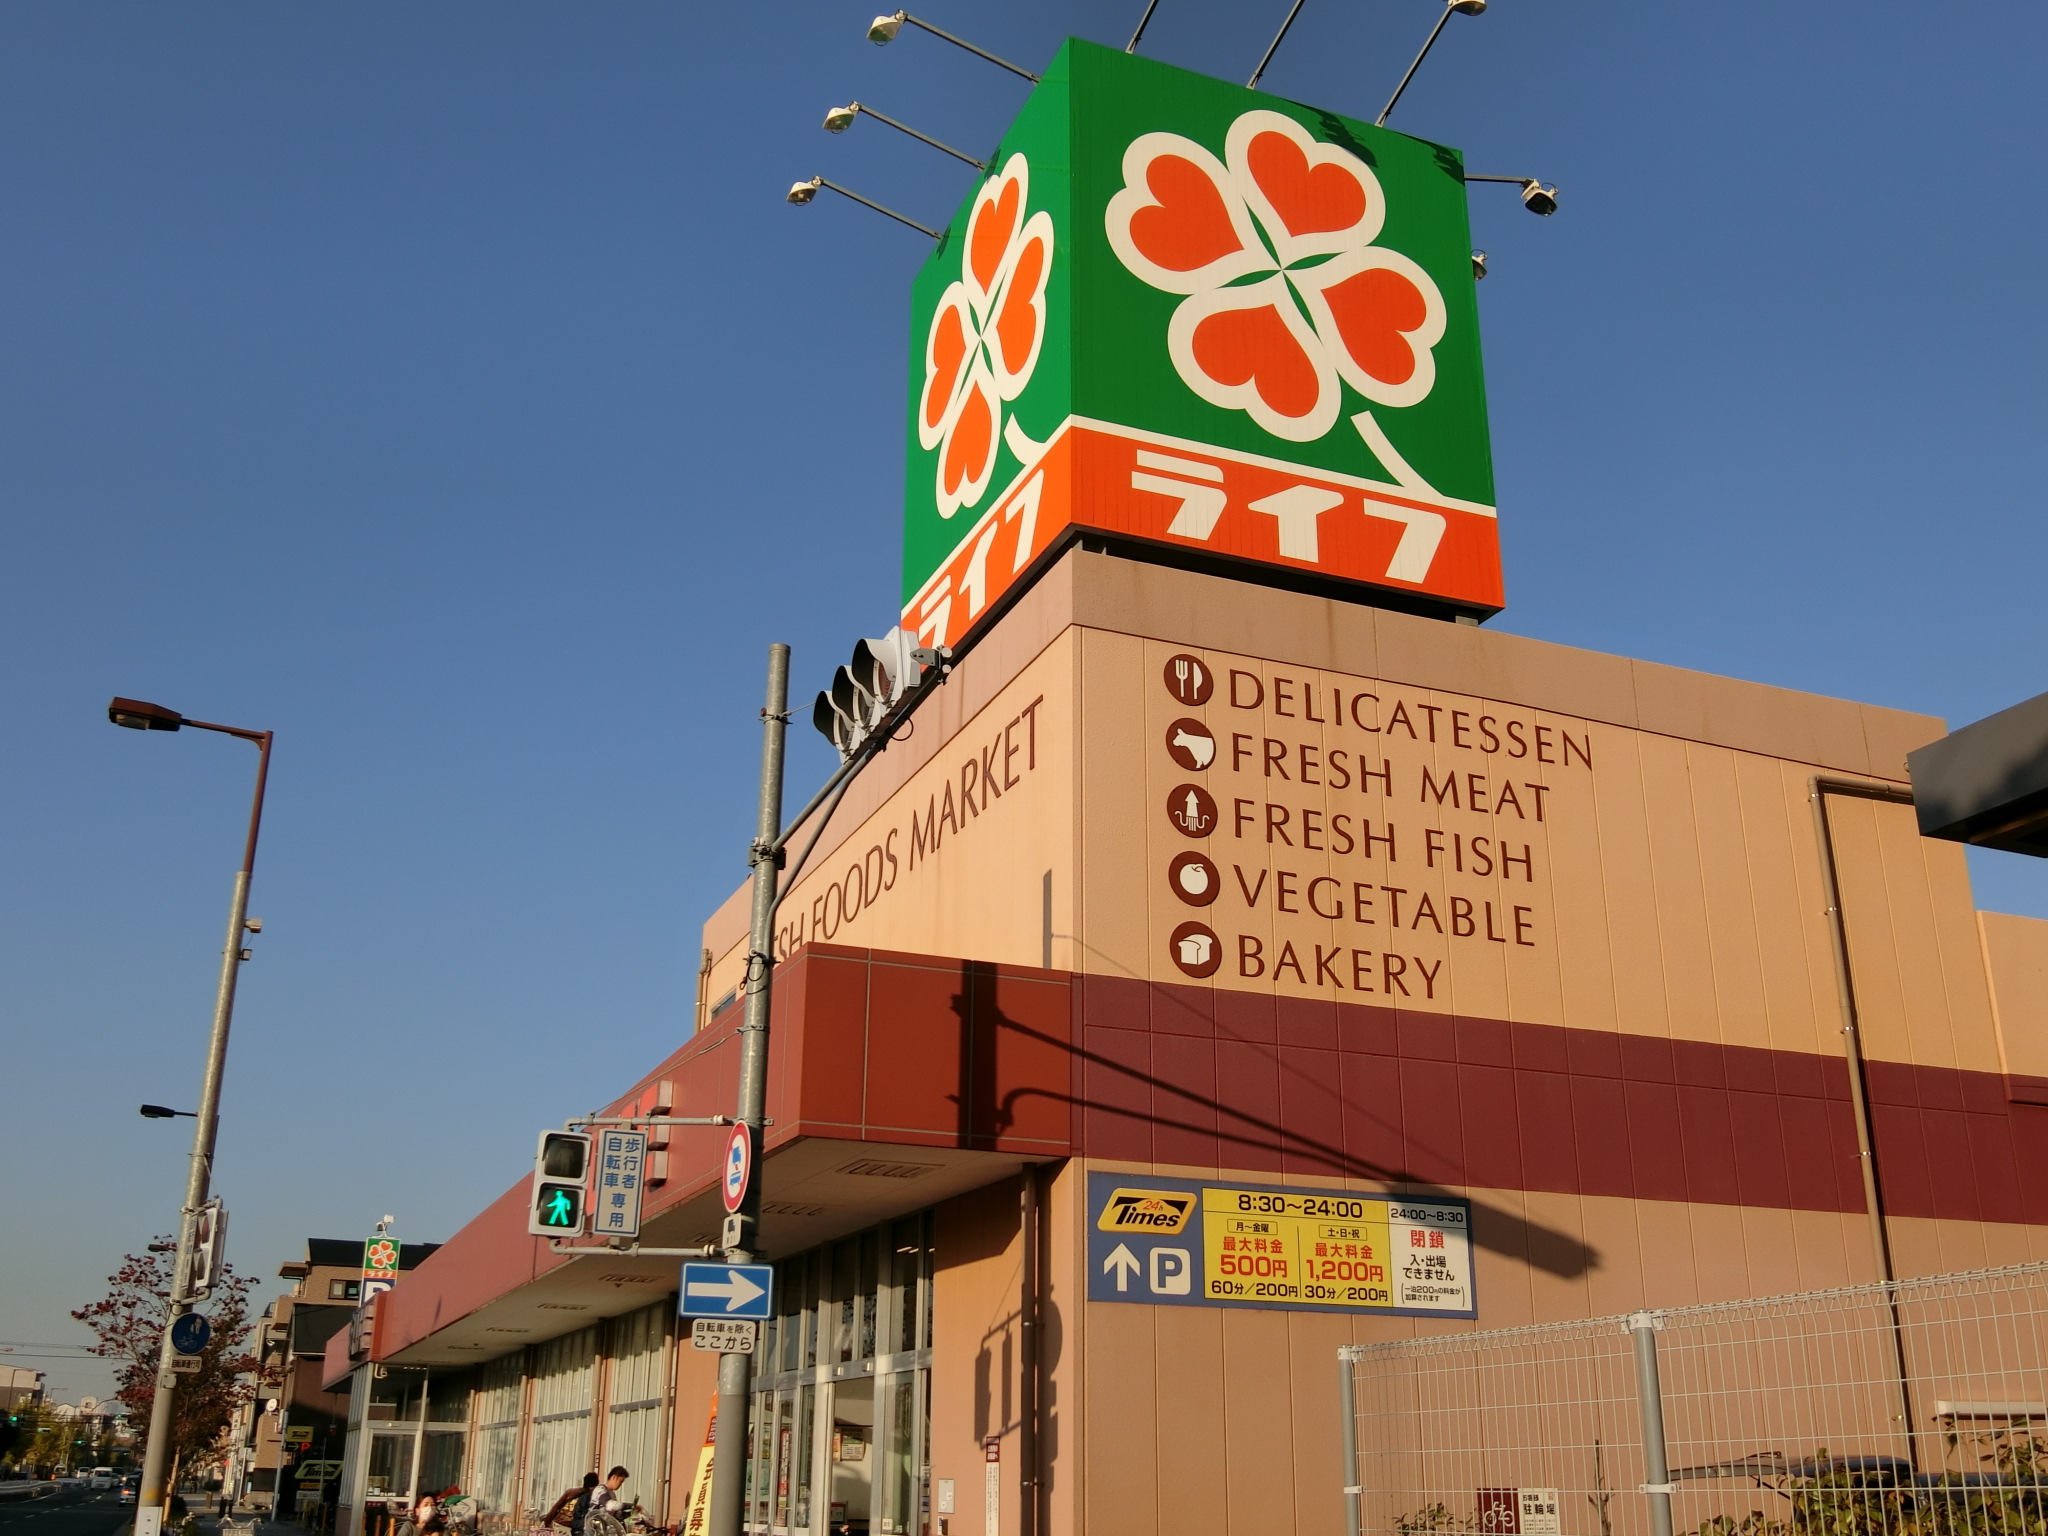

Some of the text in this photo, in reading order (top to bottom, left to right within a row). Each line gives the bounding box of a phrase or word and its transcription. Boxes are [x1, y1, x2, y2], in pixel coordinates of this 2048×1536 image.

[1131, 448, 1447, 585] ライフ
[918, 467, 1045, 651] ライフ
[1229, 668, 1593, 771] DELICATESSEN
[1232, 732, 1550, 822] FRESH MEAT
[811, 827, 898, 943] FOODS
[909, 693, 1044, 872] MARKET
[1234, 797, 1533, 883] FRESH FISH
[1233, 864, 1535, 947] VEGETABLE
[1238, 934, 1442, 1000] BAKERY
[604, 1137, 622, 1188] 自転車
[622, 1137, 640, 1189] 歩行者
[608, 1192, 626, 1228] 専用
[1115, 1203, 1181, 1227] Times
[1223, 1236, 1283, 1254] 最大料金
[1315, 1242, 1373, 1260] 最大料金
[1410, 1229, 1445, 1249] 閉鎖
[1157, 1252, 1183, 1288] P
[1220, 1254, 1288, 1278] 500円
[1306, 1259, 1384, 1283] 1,200円
[1402, 1267, 1455, 1281] できません
[1410, 1254, 1447, 1268] 入・出場
[694, 1334, 752, 1351] ここから
[696, 1322, 753, 1334] 自転車を除く
